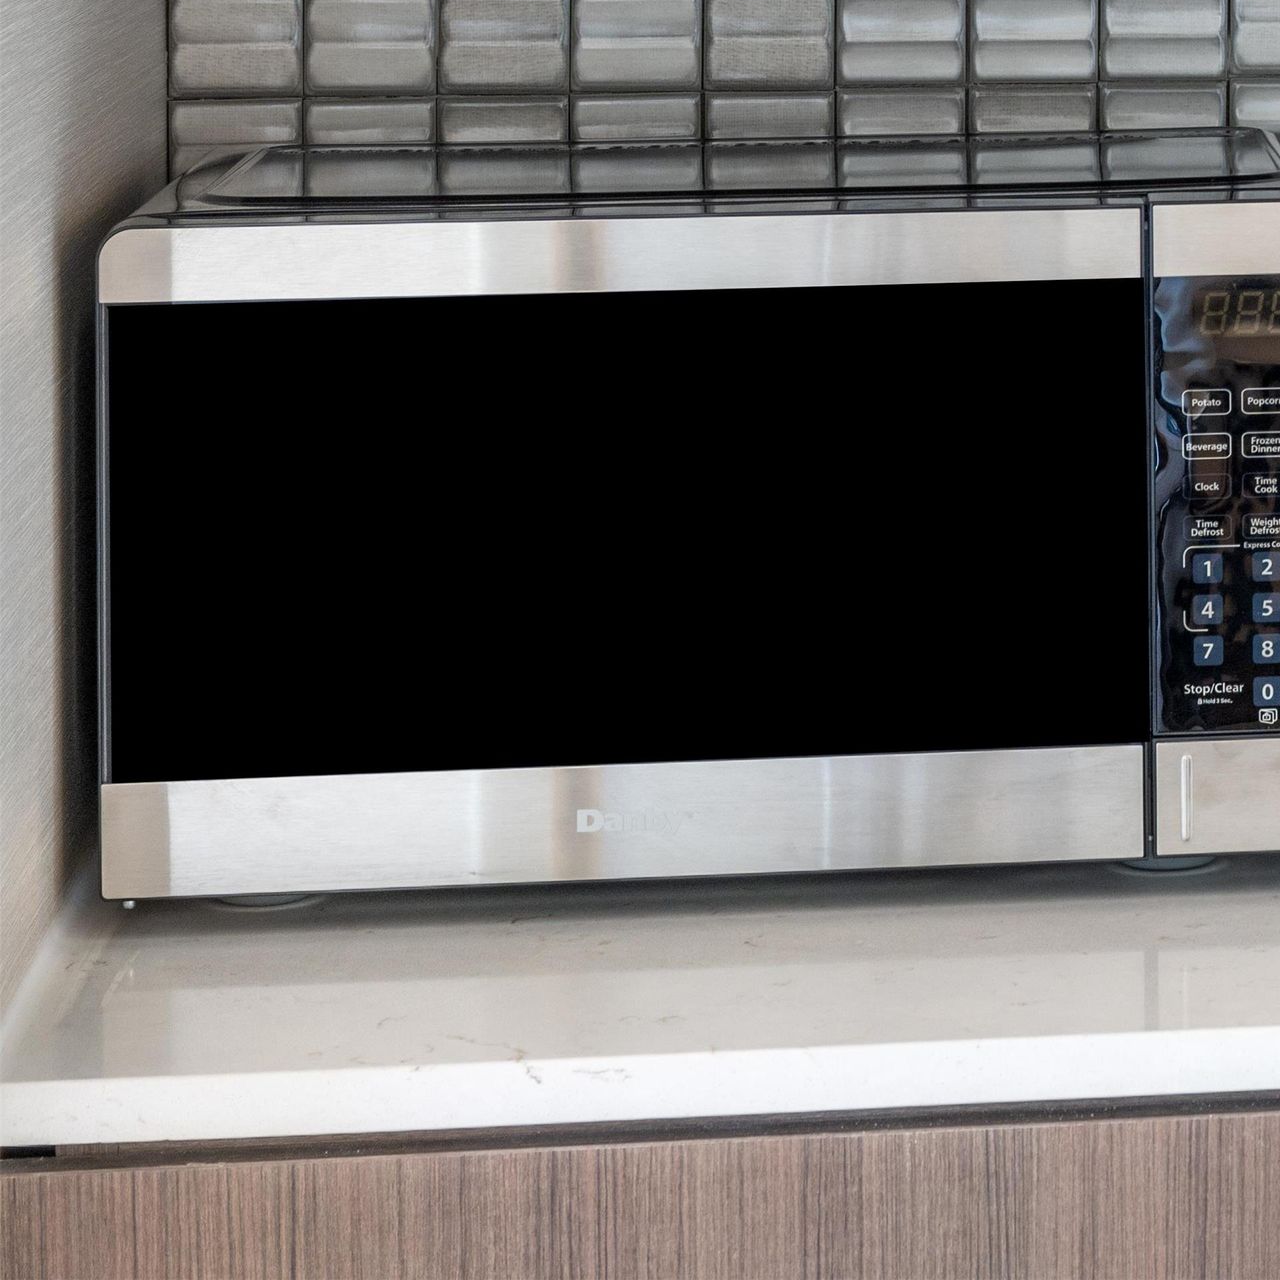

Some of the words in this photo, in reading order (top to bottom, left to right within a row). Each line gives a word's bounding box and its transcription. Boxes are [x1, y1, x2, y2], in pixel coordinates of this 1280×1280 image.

[1192, 398, 1221, 406] Potato
[1186, 443, 1228, 452] Beverage
[1251, 445, 1280, 453] Dinner
[1255, 477, 1277, 485] Time
[1195, 482, 1219, 491] Clock
[1255, 485, 1278, 494] Cook
[1196, 520, 1218, 528] Time
[1191, 528, 1224, 537] Defrost
[1243, 541, 1270, 549] Express
[1204, 561, 1211, 577] 1
[1261, 559, 1273, 575] 2
[1201, 601, 1214, 618] 4
[1262, 600, 1273, 616] 5
[1203, 643, 1214, 659] 7
[1261, 641, 1274, 657] 8
[1184, 682, 1244, 695] Stop/Clear
[1262, 683, 1274, 700] 0
